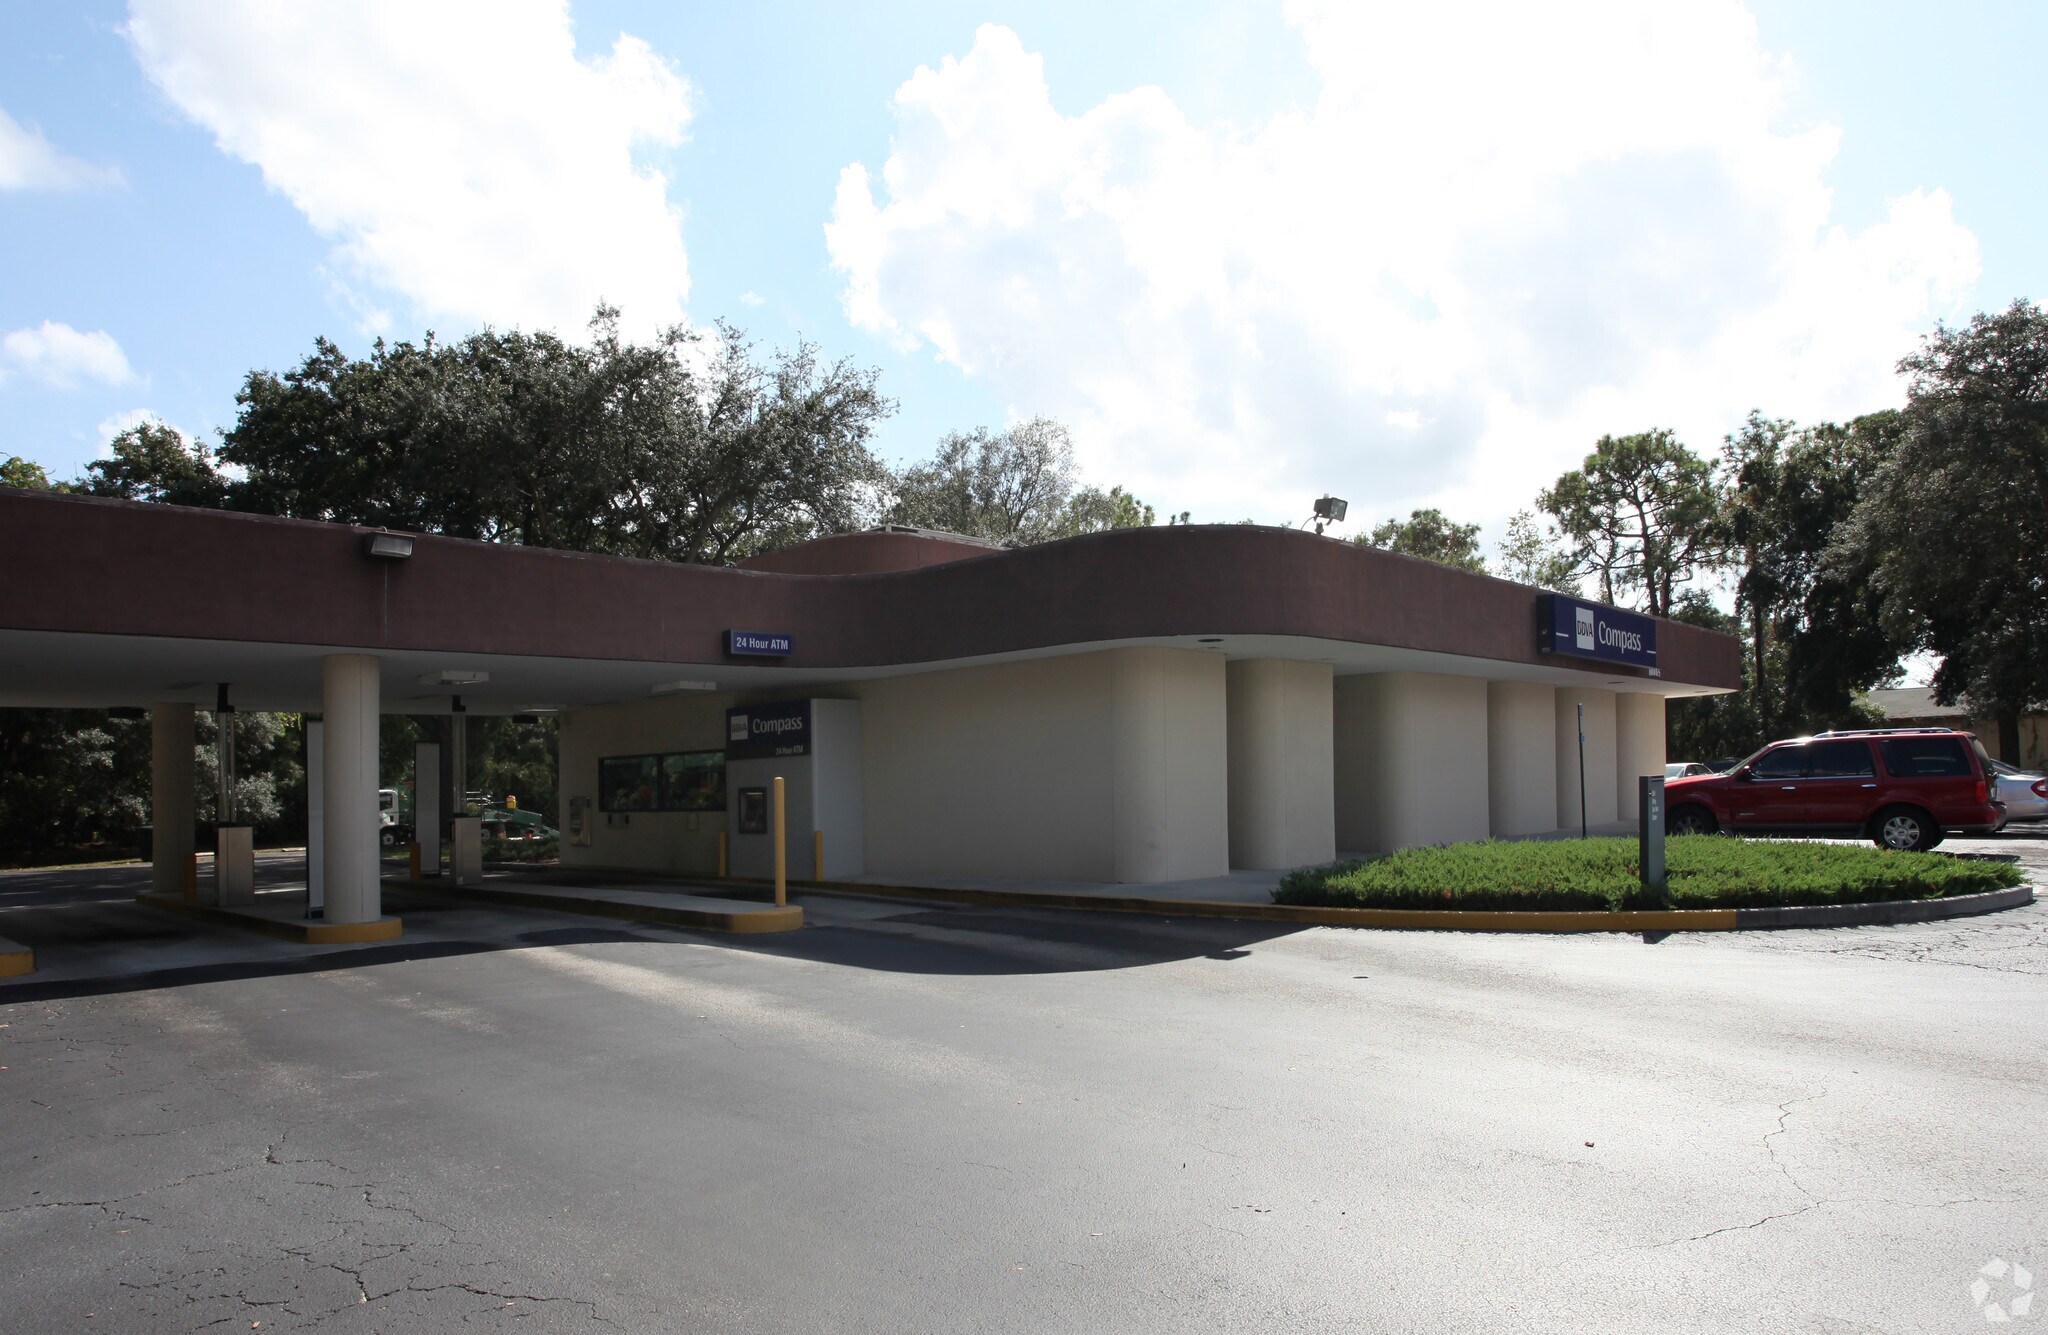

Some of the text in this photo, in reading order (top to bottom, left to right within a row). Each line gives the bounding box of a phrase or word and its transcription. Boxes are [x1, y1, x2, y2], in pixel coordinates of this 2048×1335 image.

[736, 636, 788, 650] 24 Hour ATM
[1577, 621, 1641, 653] BBVA Compass
[753, 717, 802, 735] Compass
